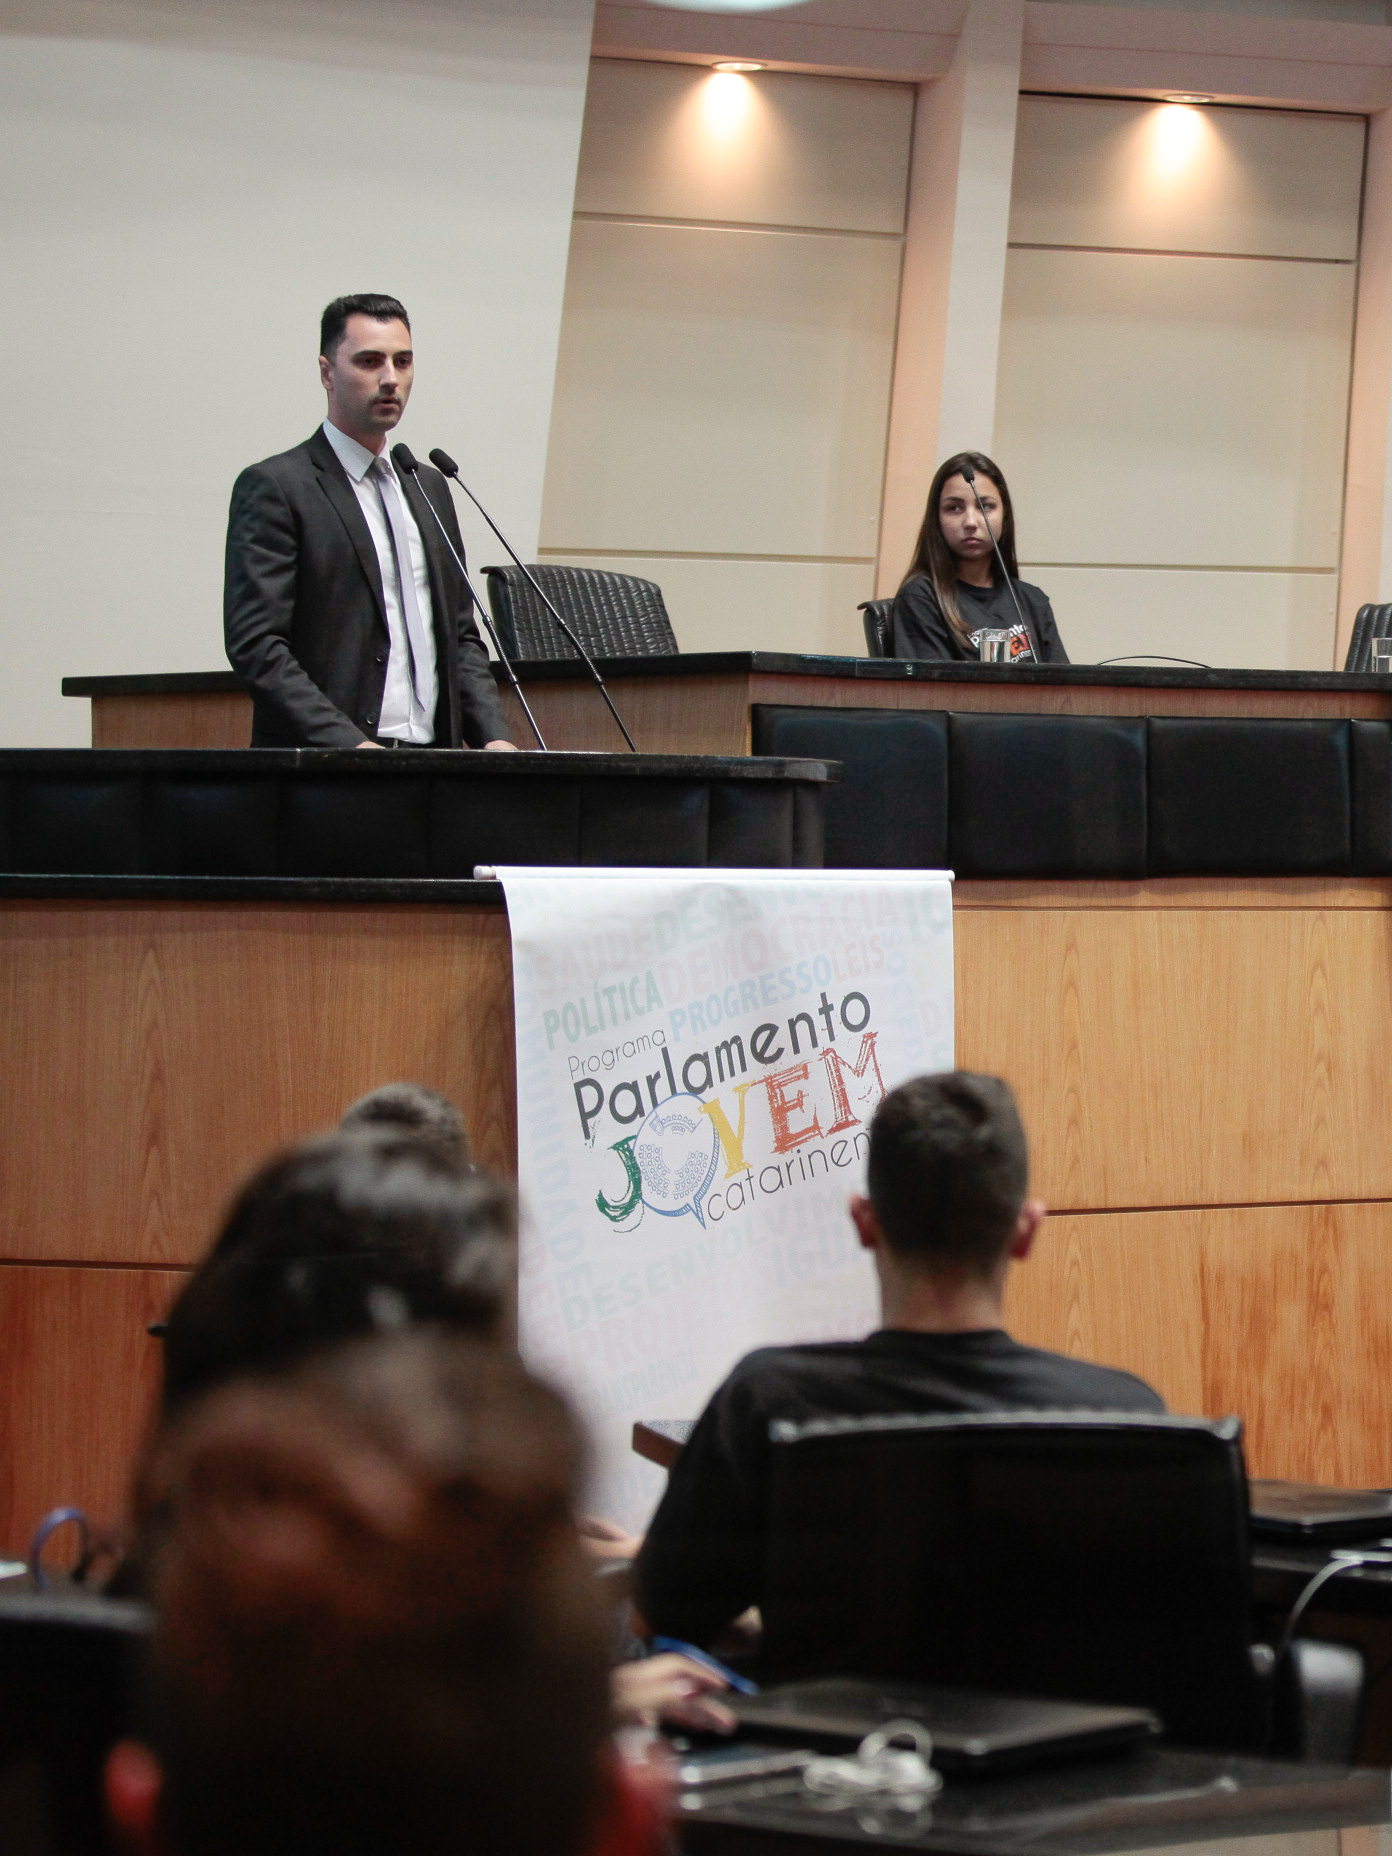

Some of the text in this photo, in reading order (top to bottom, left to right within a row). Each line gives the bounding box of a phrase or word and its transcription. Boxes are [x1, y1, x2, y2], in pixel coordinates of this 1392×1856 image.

[543, 970, 664, 1051] POLÍTICA
[667, 954, 832, 1042] PROGRESSO
[568, 1027, 667, 1079] Programa
[572, 991, 871, 1141] Parlamento
